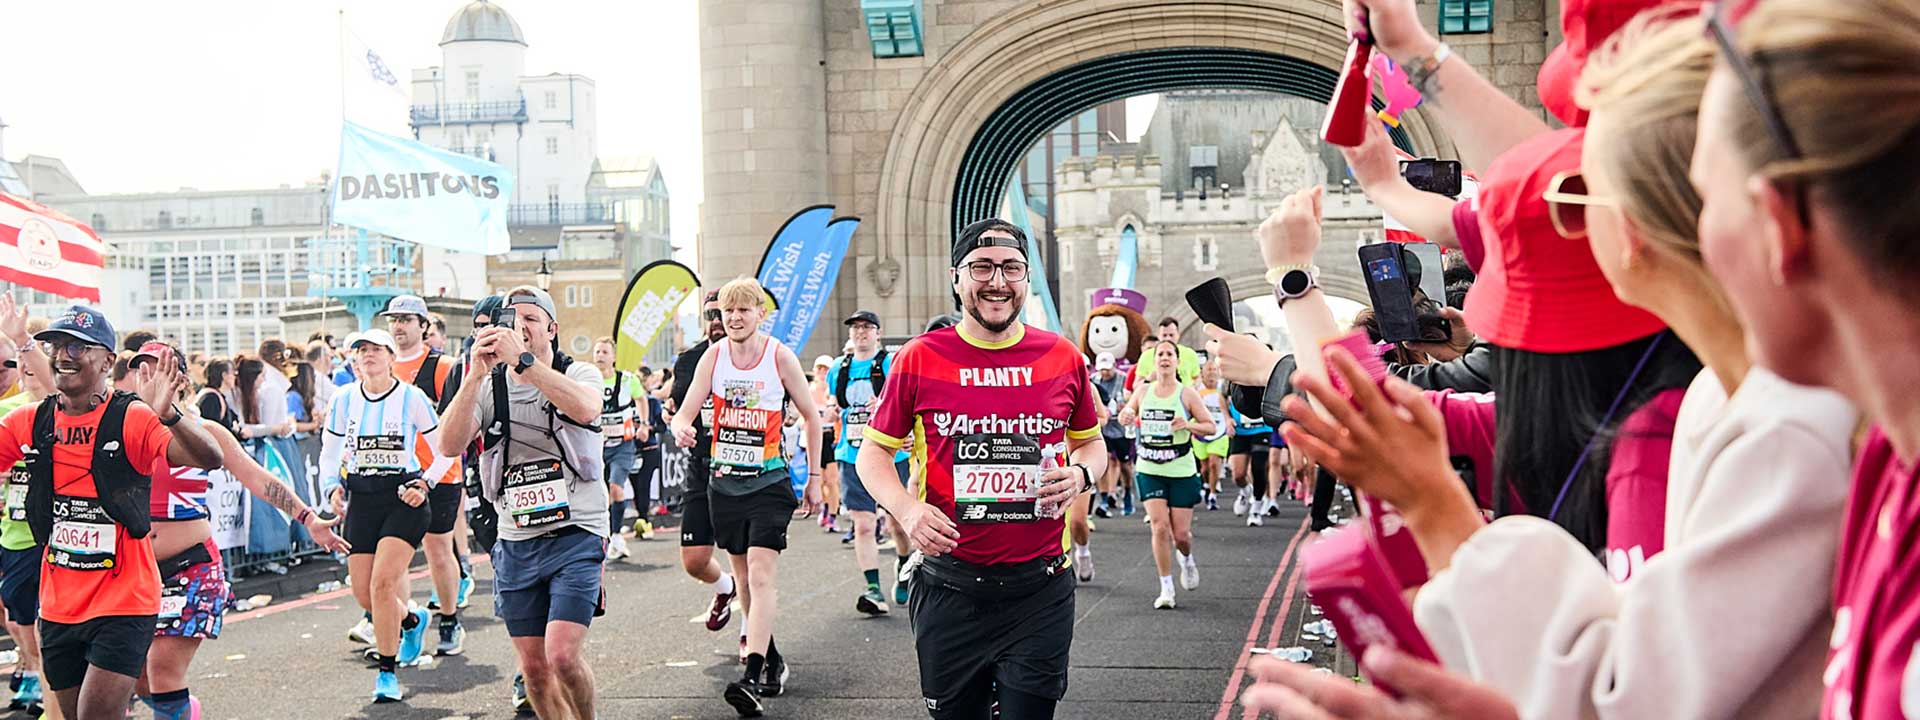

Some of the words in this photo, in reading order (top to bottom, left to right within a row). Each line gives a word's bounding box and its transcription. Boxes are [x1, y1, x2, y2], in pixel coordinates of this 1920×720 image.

[341, 172, 500, 200] DASHTONS
[959, 367, 1033, 387] PLANTY
[718, 406, 768, 430] CAMERON
[949, 412, 1053, 437] Arthritis
[53, 426, 93, 445] AJAY
[364, 453, 399, 464] 53513
[721, 447, 755, 463] 57570
[958, 439, 989, 460] tcs
[992, 445, 1035, 453] CONSULTANCY
[966, 471, 1028, 494] 27024
[514, 487, 556, 508] 25913
[53, 501, 69, 517] cs
[962, 505, 988, 520] NB
[1003, 512, 1033, 520] balance
[55, 525, 100, 549] 20641
